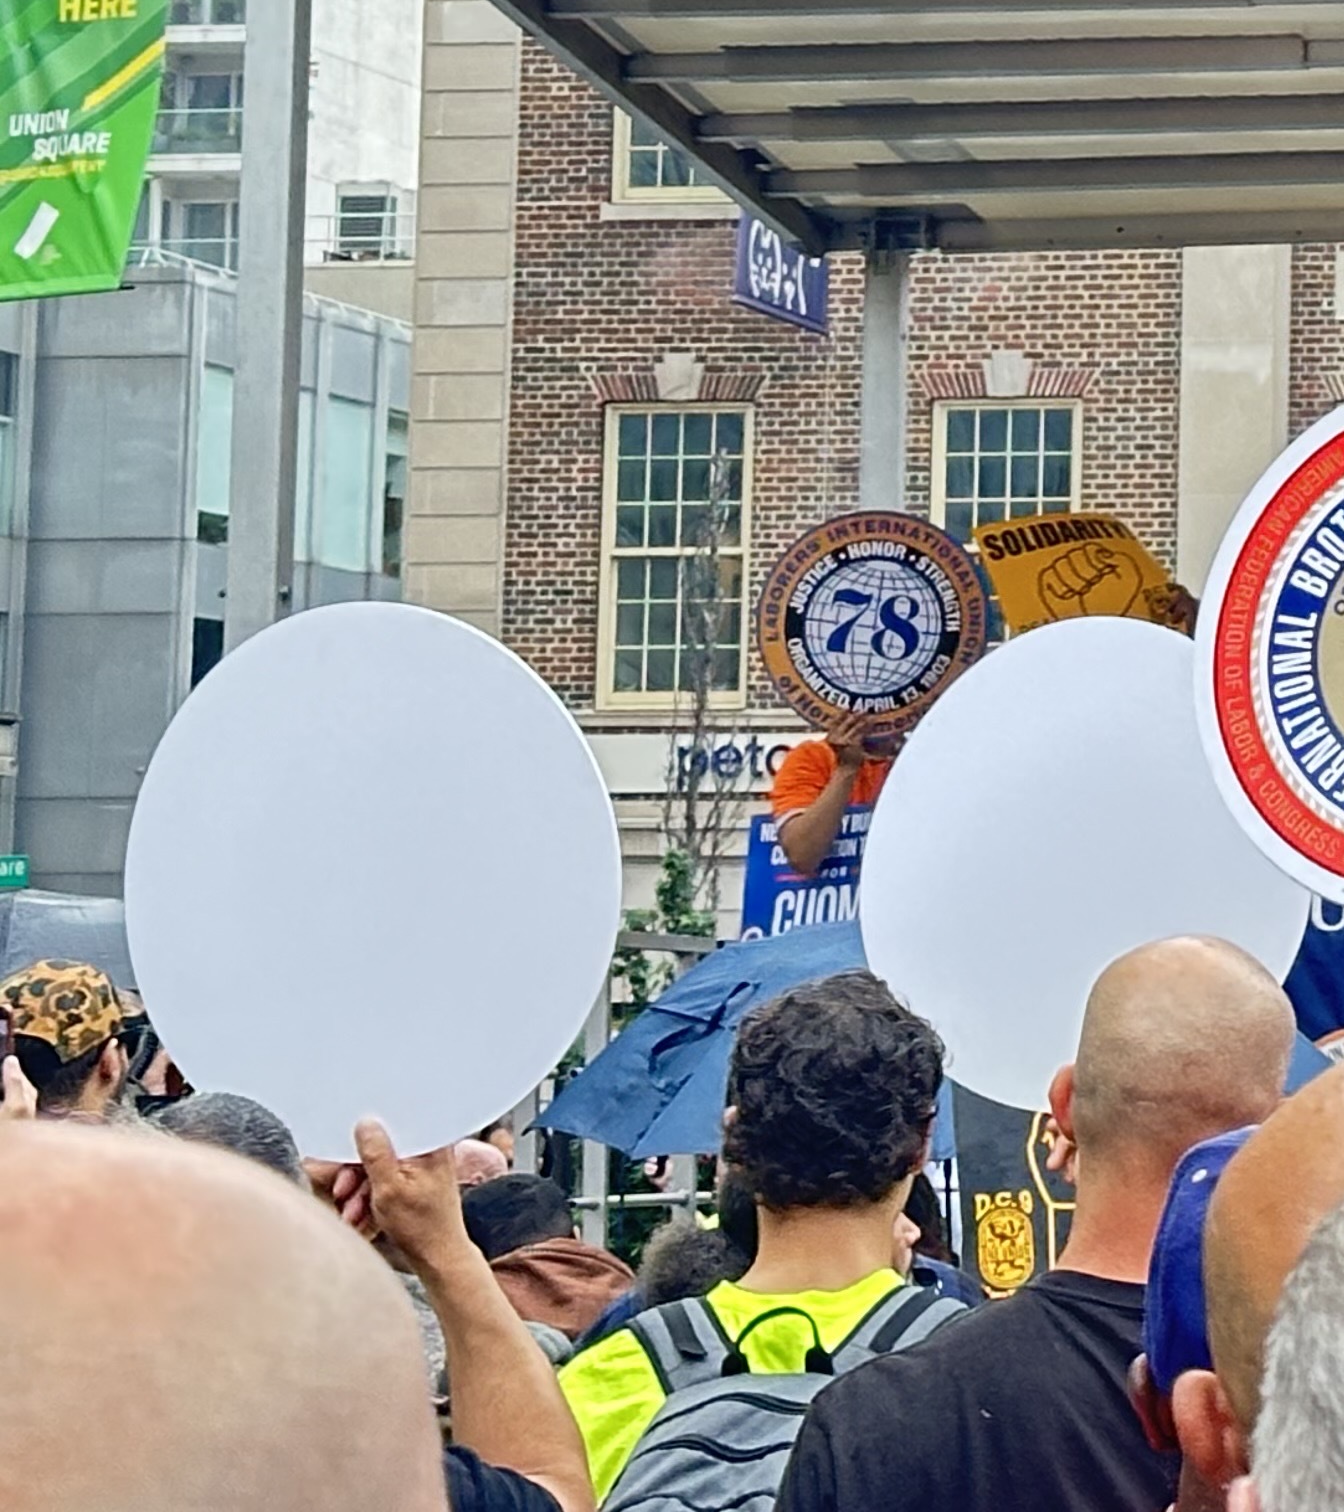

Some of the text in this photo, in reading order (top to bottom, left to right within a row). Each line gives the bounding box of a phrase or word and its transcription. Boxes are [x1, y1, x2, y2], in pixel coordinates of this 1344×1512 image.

[9, 108, 70, 137] UNION
[32, 132, 112, 163] SQUARE
[789, 541, 961, 633] JUSTICE HONOR STRENGTH
[827, 519, 976, 594] INTERNATIONAL
[826, 588, 920, 661] 78
[962, 596, 982, 664] UNION
[1222, 535, 1273, 661] FEDERATION
[797, 698, 836, 725] Nor
[852, 694, 900, 713] APRIL
[1223, 666, 1243, 692] OF
[1224, 696, 1259, 763] LABOR
[1249, 763, 1266, 781] &
[1259, 779, 1342, 860] CONGRESS
